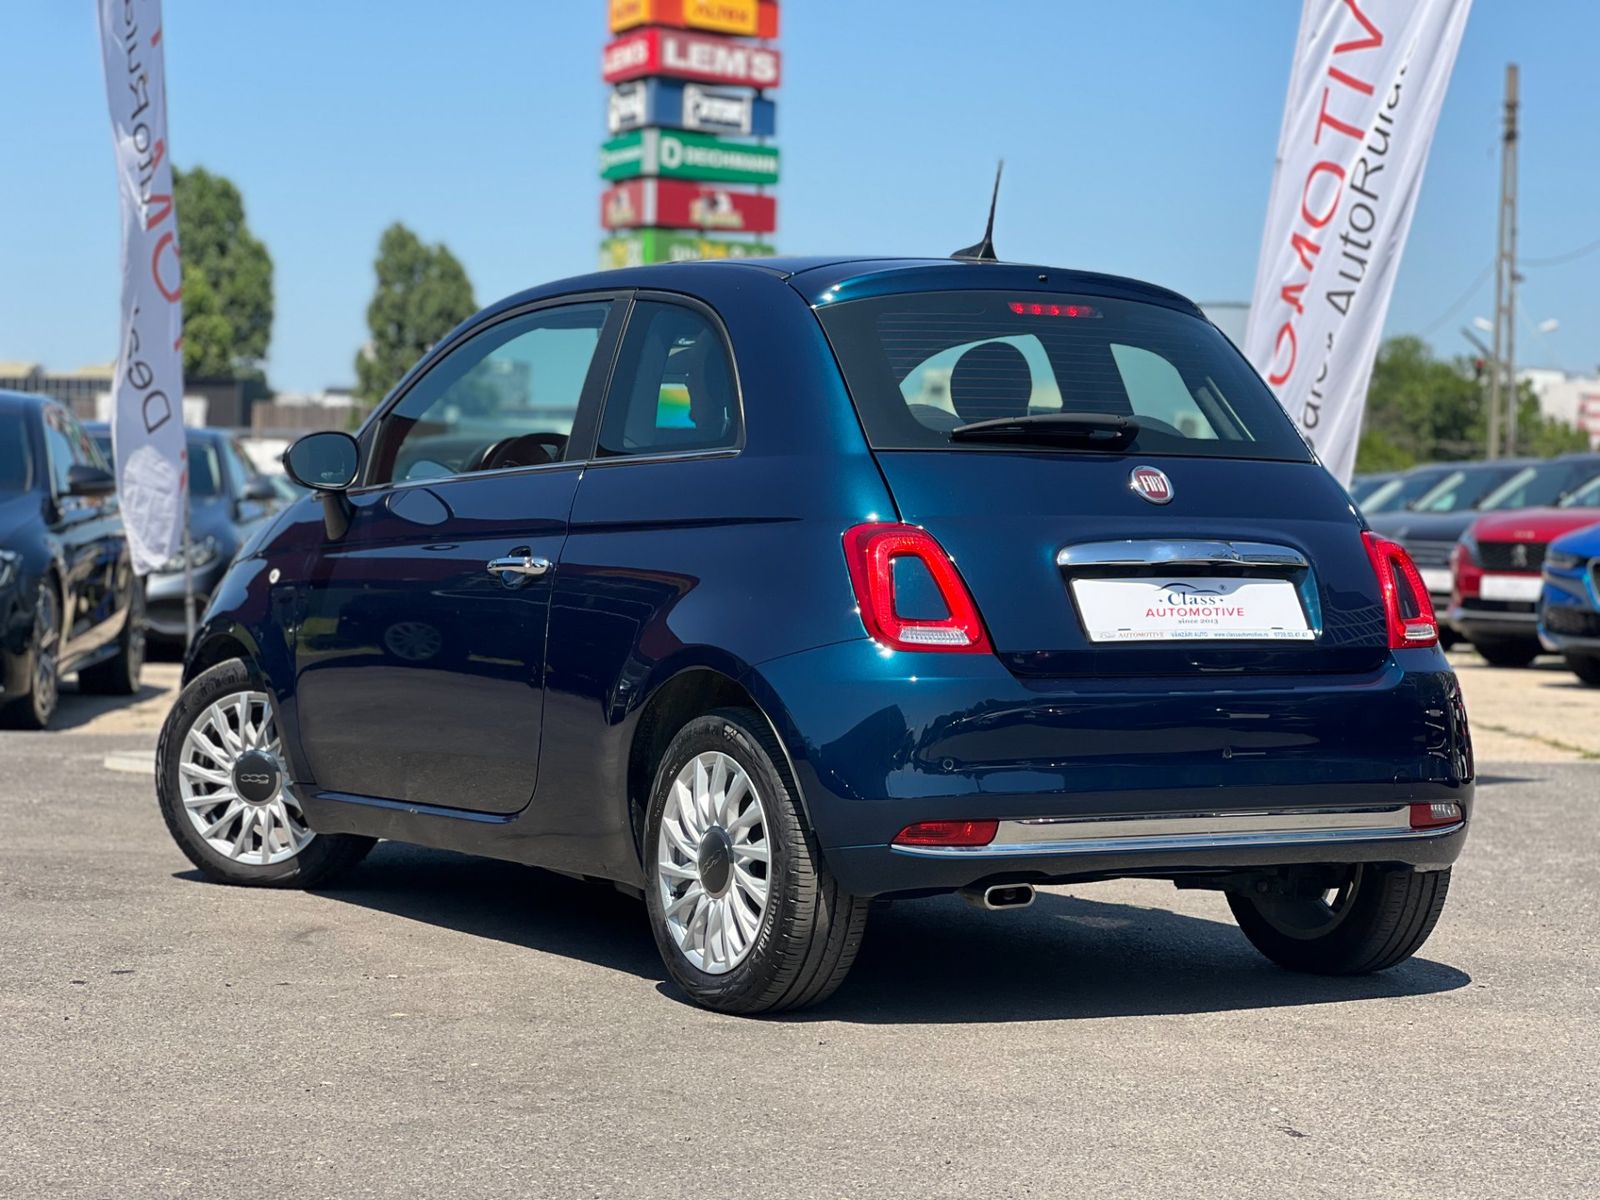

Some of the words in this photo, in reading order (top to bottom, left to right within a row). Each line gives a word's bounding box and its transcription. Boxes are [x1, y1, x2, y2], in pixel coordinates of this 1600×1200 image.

[1139, 475, 1166, 492] FIAT
[1167, 591, 1217, 606] Class
[1145, 607, 1245, 618] AUTOMOTIVE
[1200, 618, 1219, 626] 2013
